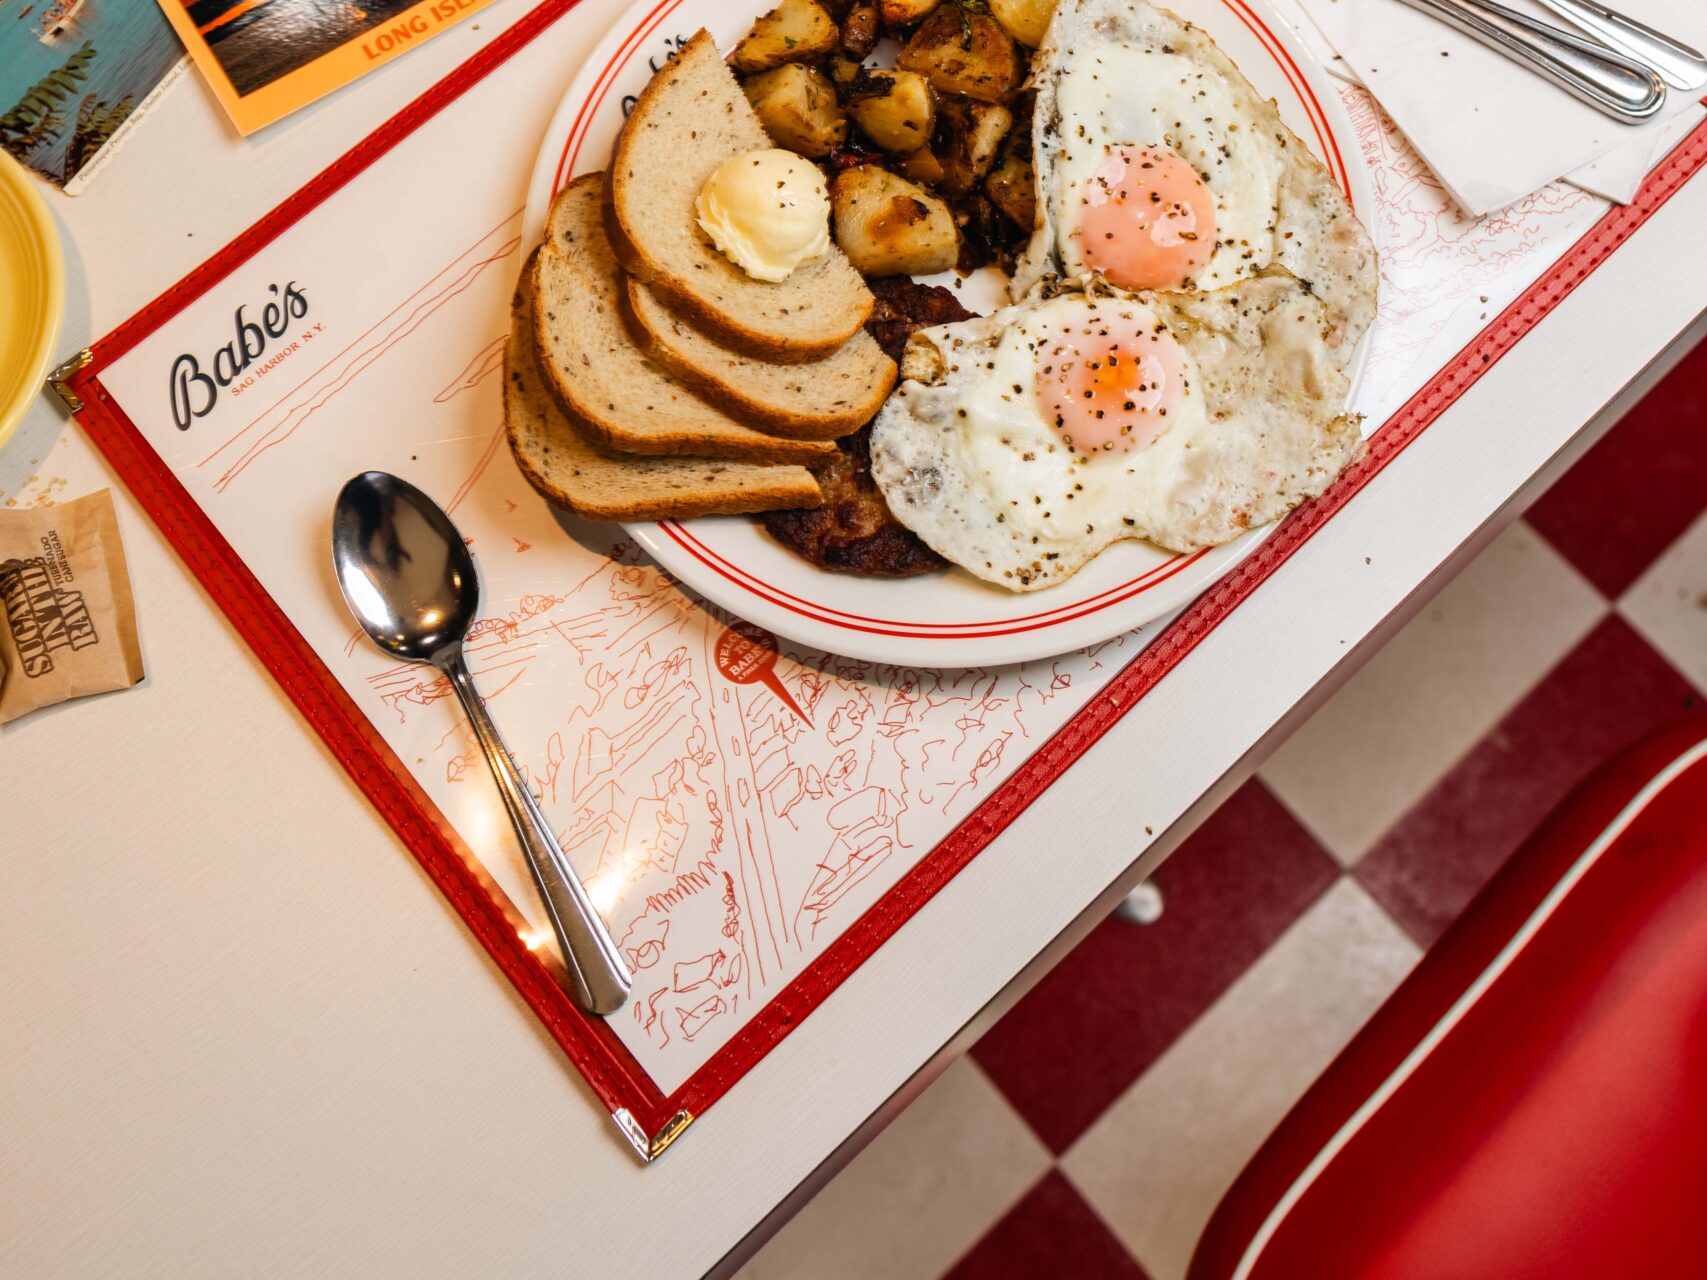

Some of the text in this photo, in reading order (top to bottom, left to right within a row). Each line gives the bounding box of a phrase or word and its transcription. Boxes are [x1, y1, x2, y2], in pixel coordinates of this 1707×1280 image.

[360, 16, 429, 61] LONG
[169, 280, 308, 432] Babe's
[231, 322, 327, 397] SAG HARBOR N.Y.
[37, 613, 71, 652] IN
[53, 588, 99, 652] RAW
[728, 637, 771, 676] BABES
[732, 638, 751, 655] TO
